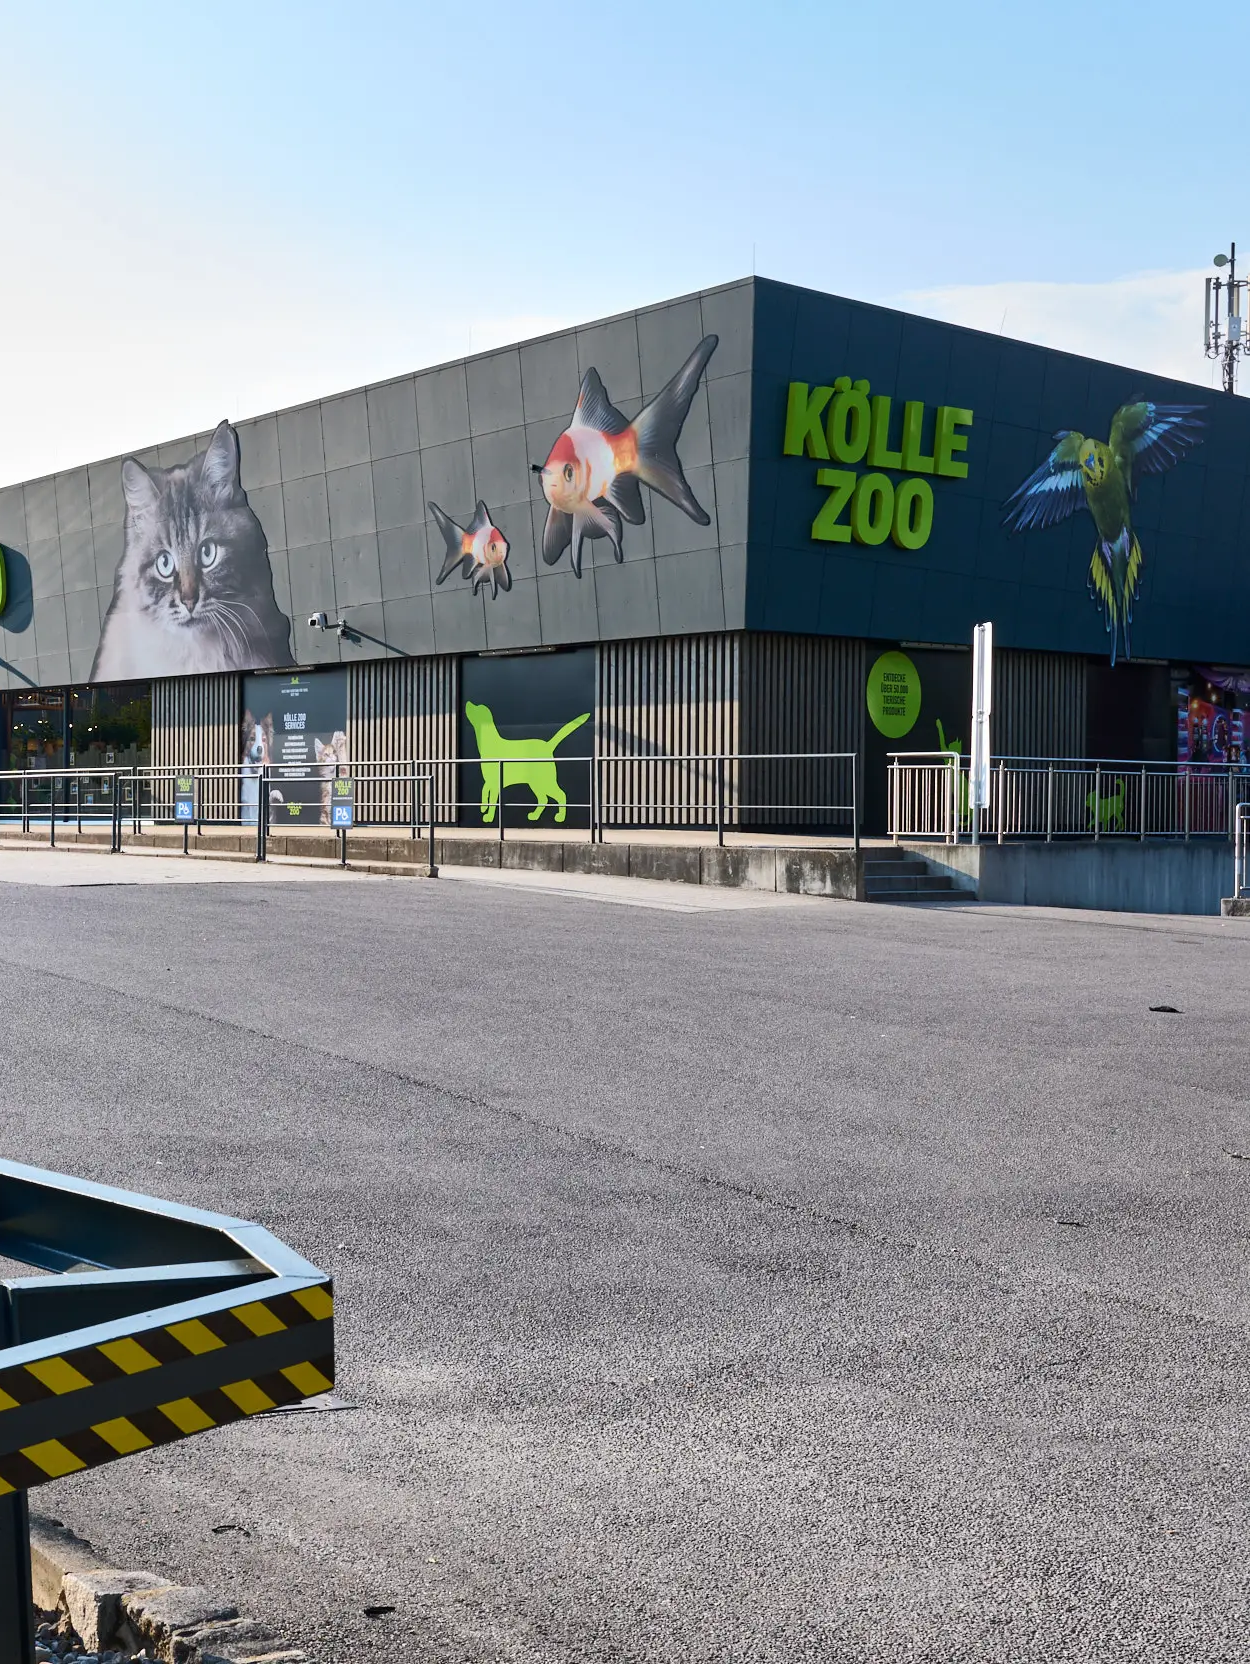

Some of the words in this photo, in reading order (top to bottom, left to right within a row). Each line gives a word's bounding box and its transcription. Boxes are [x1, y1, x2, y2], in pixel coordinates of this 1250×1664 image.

[783, 376, 973, 479] KÖLLE
[811, 468, 934, 550] ZOO
[883, 672, 906, 682] ENTDECKE
[883, 695, 906, 705] TIERISCHE
[882, 707, 906, 716] PRODUKTE
[284, 721, 306, 730] SERVICES
[335, 807, 342, 821] P
